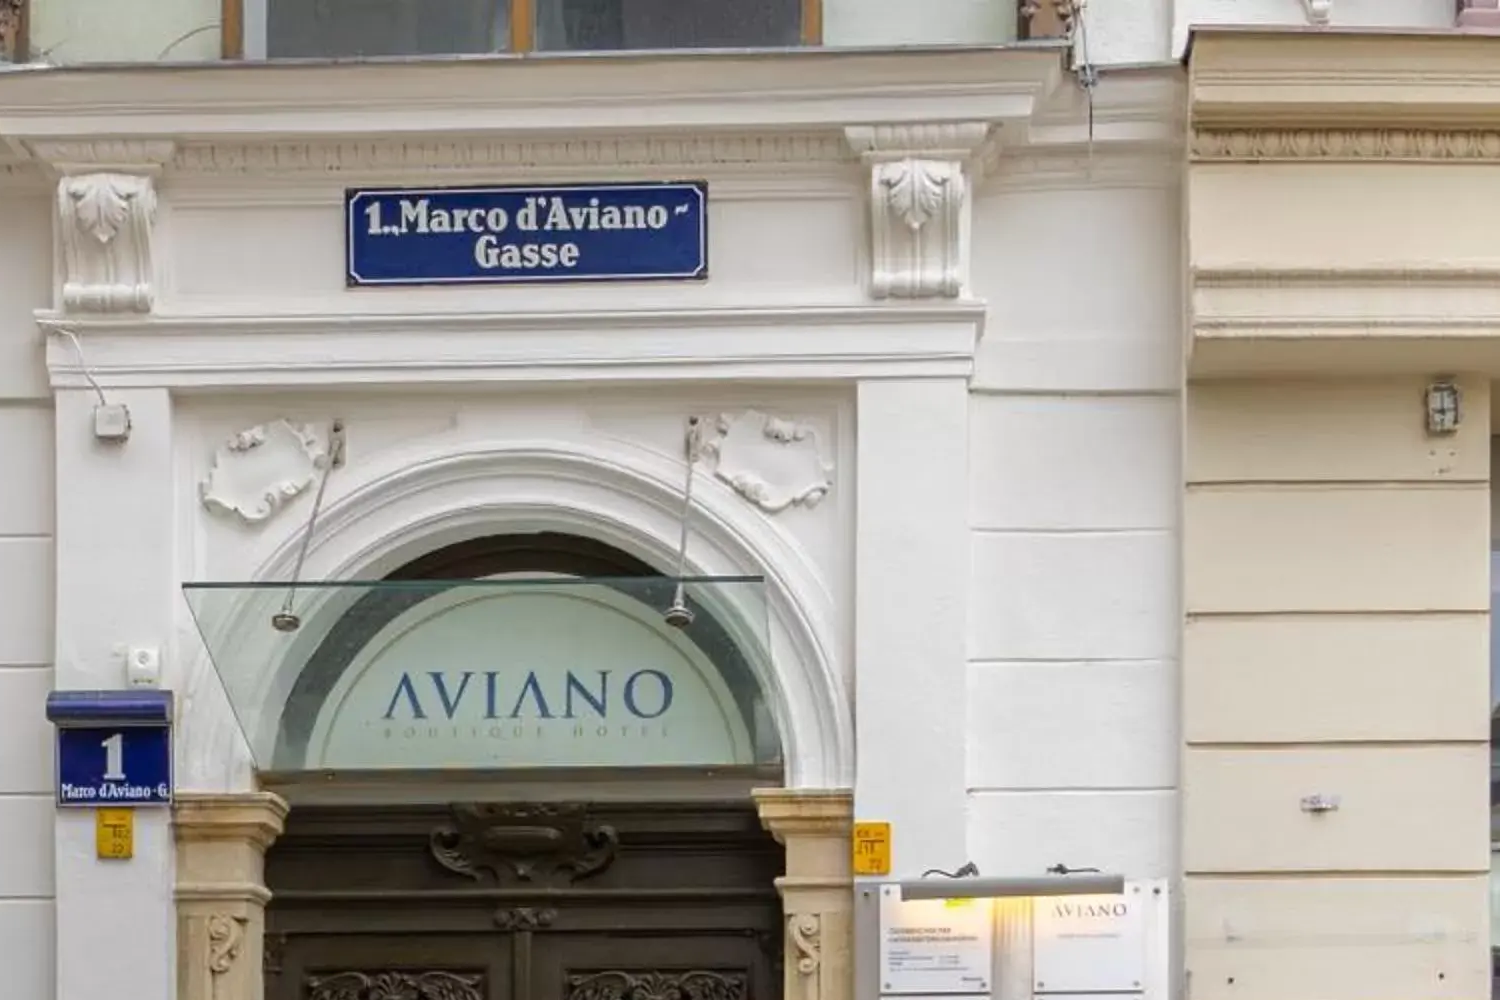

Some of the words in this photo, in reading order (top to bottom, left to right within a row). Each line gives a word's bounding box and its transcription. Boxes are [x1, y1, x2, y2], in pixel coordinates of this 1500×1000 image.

[474, 235, 580, 269] Gasse
[381, 668, 674, 719] AVIANO
[381, 725, 545, 741] BOUTIQUE
[572, 725, 670, 738] HOTEL
[101, 733, 126, 781] 1
[61, 783, 96, 798] Marco
[1052, 903, 1127, 918] AVIANO
